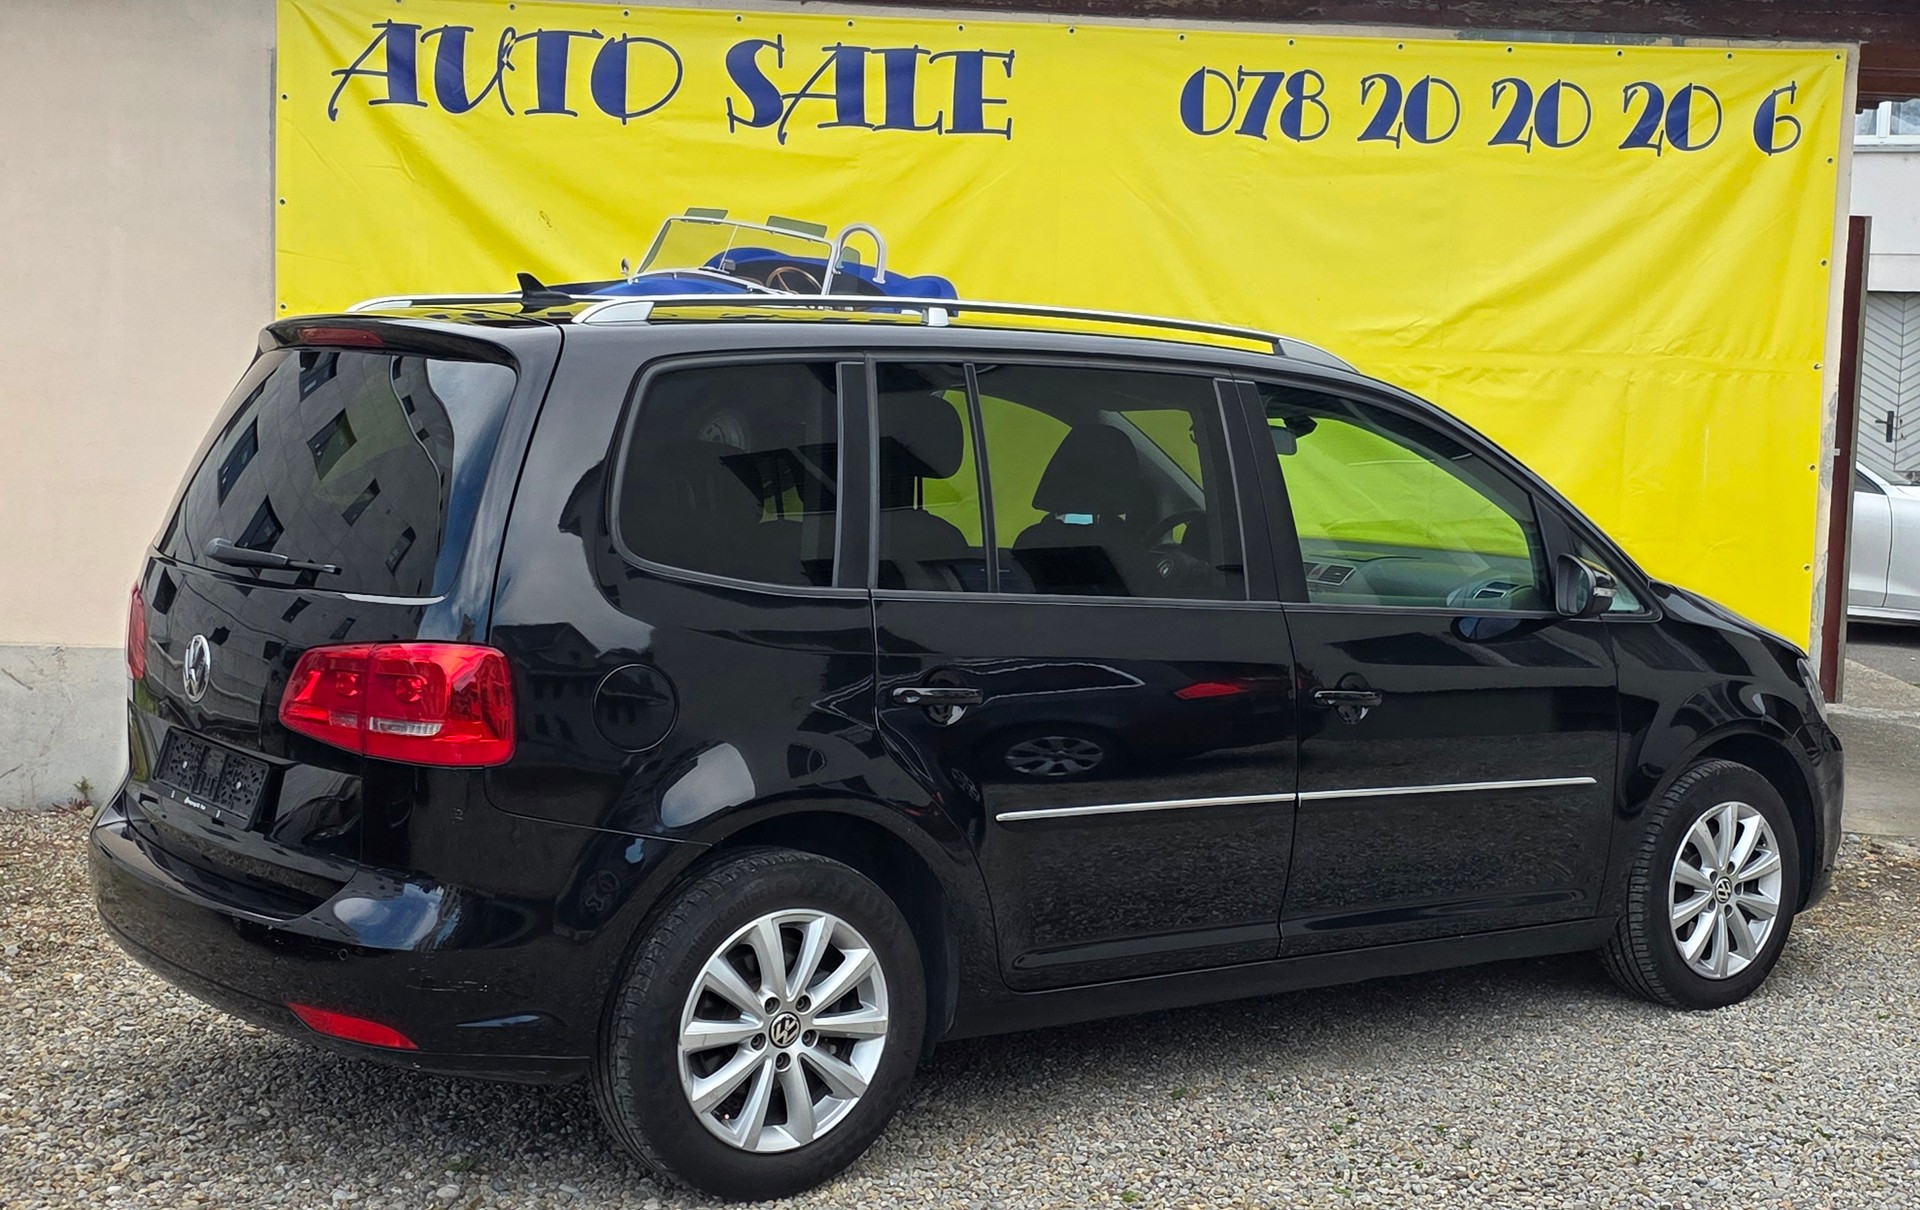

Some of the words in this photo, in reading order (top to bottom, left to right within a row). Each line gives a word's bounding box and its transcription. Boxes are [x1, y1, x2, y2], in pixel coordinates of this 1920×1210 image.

[328, 19, 682, 125] AUTO
[726, 34, 1015, 145] SALE
[1180, 65, 1329, 142] 078
[1357, 74, 1460, 149] 20
[1488, 78, 1591, 153] 20
[1619, 82, 1722, 157] 20
[1753, 81, 1801, 156] 6
